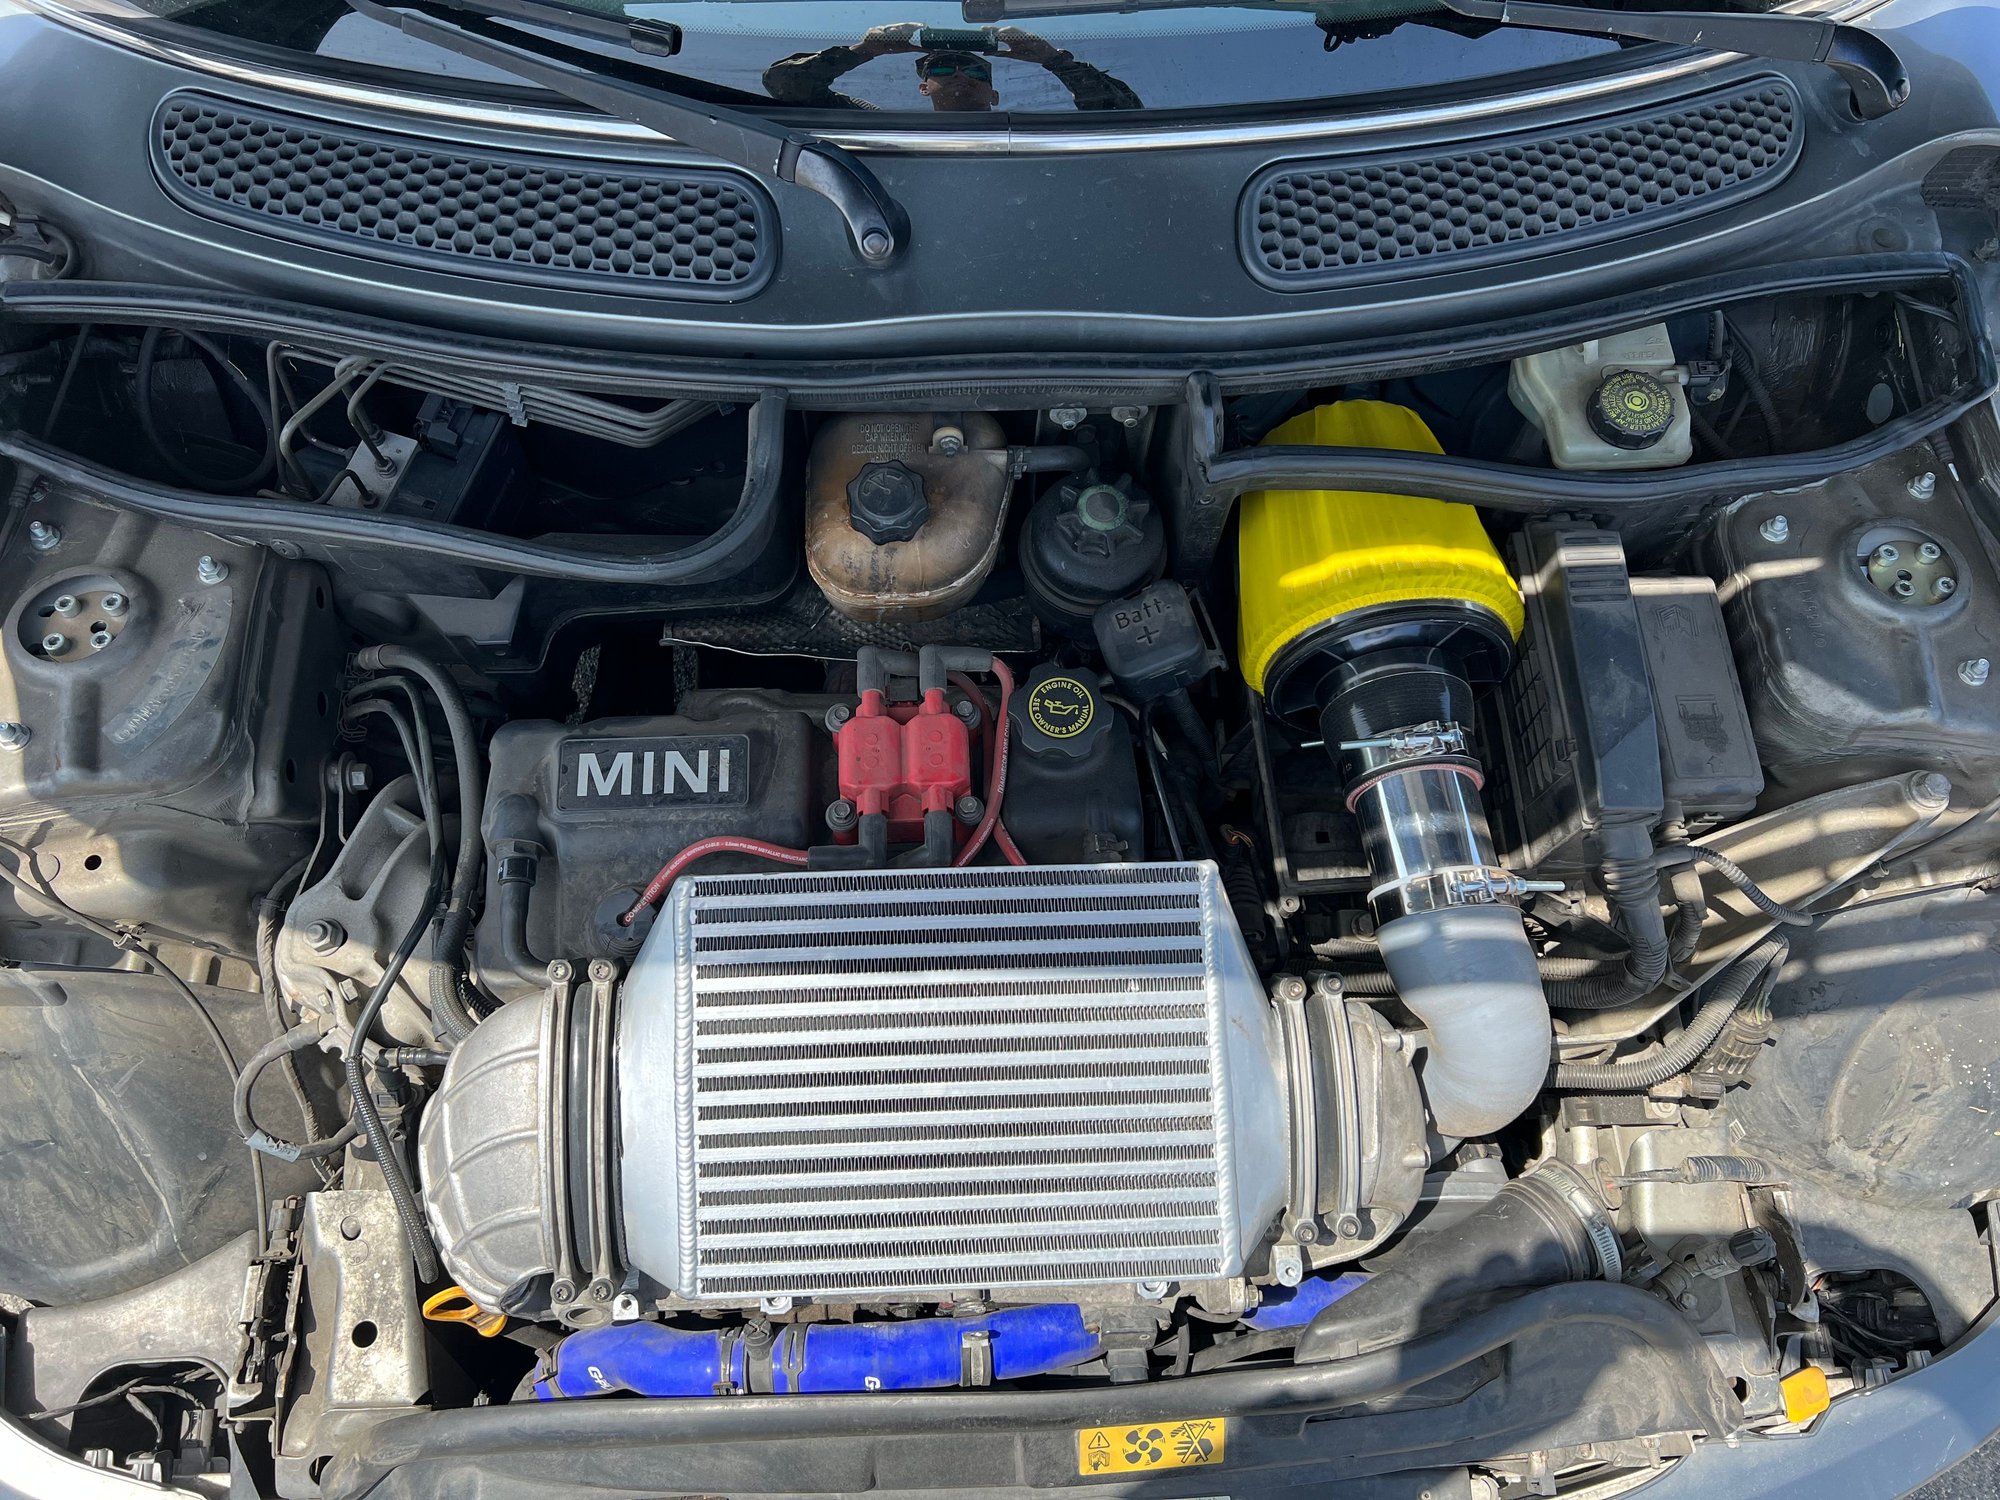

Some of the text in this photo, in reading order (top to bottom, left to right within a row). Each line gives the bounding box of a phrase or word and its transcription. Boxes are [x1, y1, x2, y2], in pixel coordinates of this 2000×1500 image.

[1041, 681, 1085, 699] ENGINE OIL
[1033, 697, 1089, 734] SEE OWNER'S MANUAL
[576, 749, 730, 797] MINI
[625, 882, 661, 922] COMPETITION
[704, 841, 720, 849] CABLE
[758, 847, 781, 857] METALLIC
[781, 853, 809, 862] INDUCTANC
